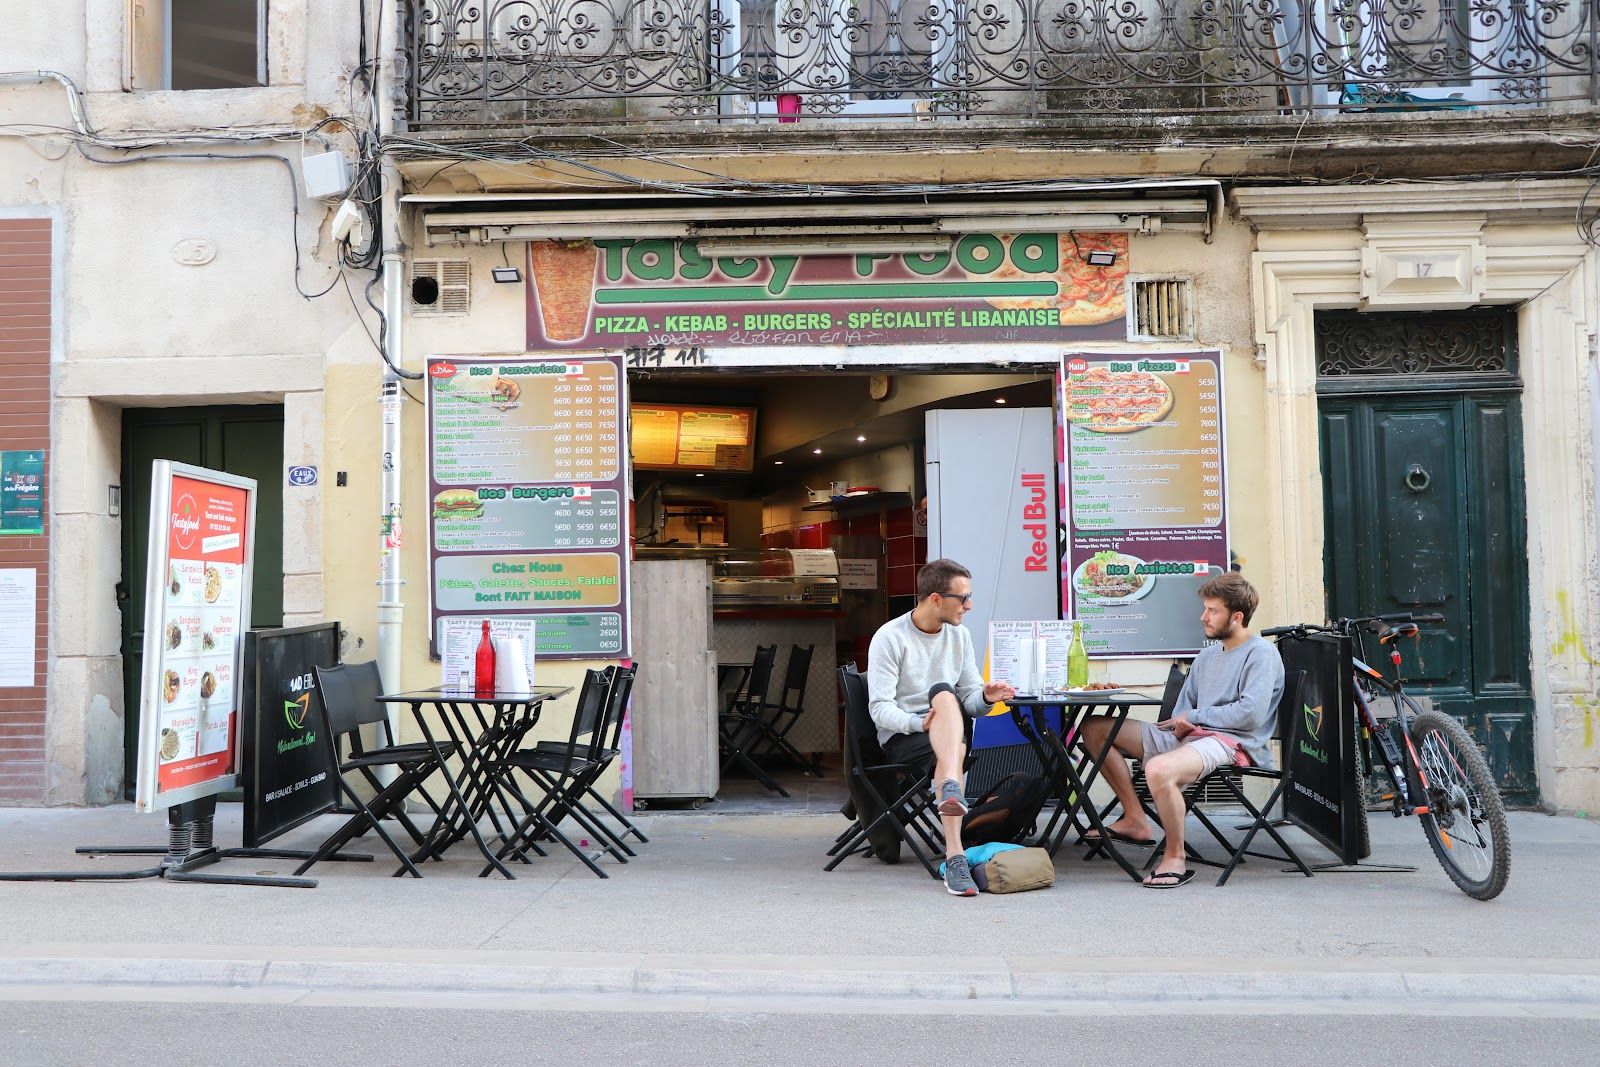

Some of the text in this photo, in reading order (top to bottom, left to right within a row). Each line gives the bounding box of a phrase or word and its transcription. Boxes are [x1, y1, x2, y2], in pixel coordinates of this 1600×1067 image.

[1416, 263, 1432, 278] 17
[595, 317, 649, 334] PIZZA
[665, 316, 728, 332] KEBAB
[744, 312, 832, 330] BURGERS
[848, 308, 956, 329] SPÉCIALITÉ
[962, 308, 1060, 328] LIBANAISE
[470, 363, 567, 376] Nos Sandwichs
[1068, 362, 1086, 370] Halal
[1110, 360, 1176, 372] Nos Pizzas
[478, 486, 574, 500] Nos Burgers
[1021, 473, 1047, 572] Red Bull
[492, 562, 563, 574] Chez Nous
[1107, 561, 1194, 575] Nos Assiettes
[528, 576, 574, 587] Sauces,
[578, 575, 616, 585] Falafel
[475, 591, 581, 602] Sont FAIT MAISON
[277, 785, 292, 798] SALADE
